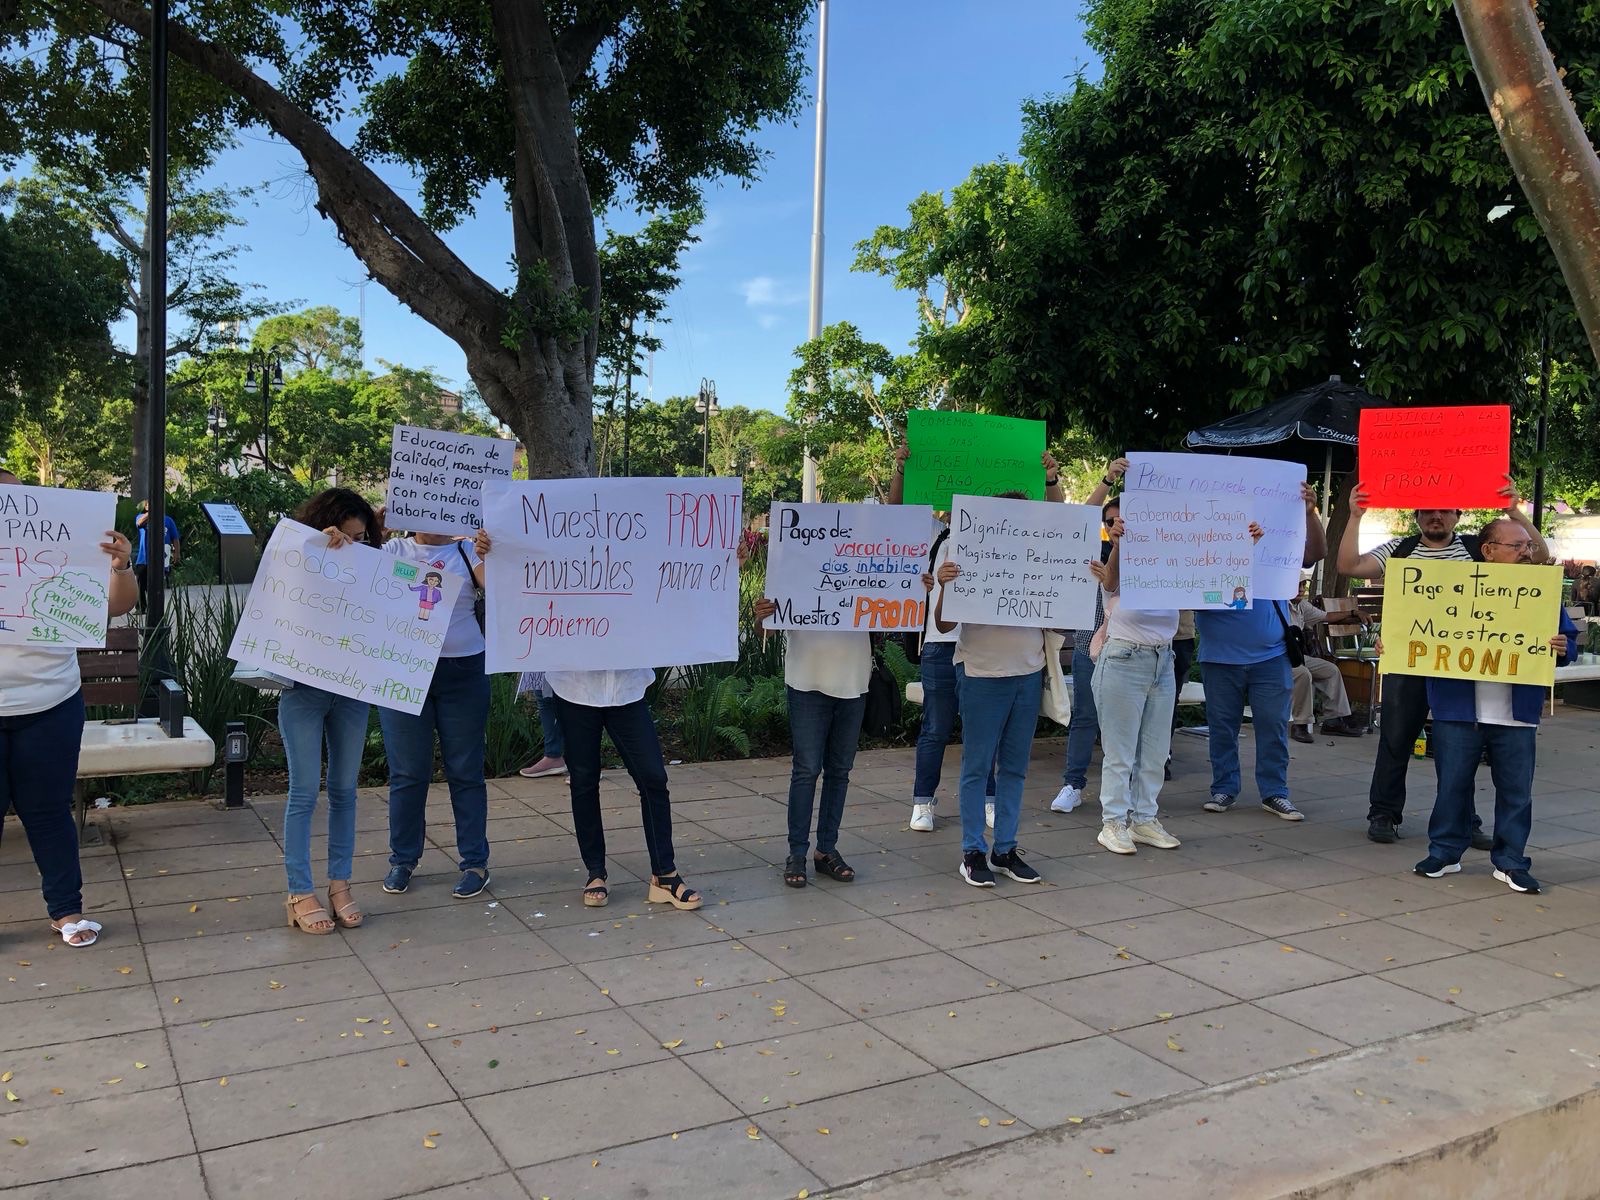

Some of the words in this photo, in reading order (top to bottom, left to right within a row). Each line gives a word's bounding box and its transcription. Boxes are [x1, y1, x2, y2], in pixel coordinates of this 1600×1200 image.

[984, 420, 1015, 431] TODOS
[1374, 411, 1444, 423] JUSTICIA
[1456, 410, 1465, 419] A
[1478, 410, 1502, 420] LAS
[400, 430, 475, 456] Educación
[484, 444, 500, 460] de
[1371, 448, 1396, 459] PARA
[1410, 447, 1431, 457] LOS
[391, 466, 405, 480] de
[452, 461, 510, 476] maestros
[975, 456, 1026, 470] NUESTRO
[936, 474, 973, 488] PAGO
[1137, 462, 1183, 491] PRONI
[1189, 480, 1209, 493] no
[1383, 473, 1454, 491] PRONI
[393, 486, 417, 499] con
[392, 500, 456, 523] laborales
[522, 492, 647, 541] Maestros
[665, 492, 740, 550] PRONI
[1124, 497, 1201, 524] Gobernador
[5, 518, 71, 542] PARA
[779, 508, 826, 546] Pagos
[829, 509, 853, 539] de:
[959, 508, 1063, 544] Dignificación
[1072, 522, 1088, 543] al
[1235, 531, 1245, 541] a
[834, 538, 929, 558] vacaciones
[956, 544, 1018, 564] Magisterio
[1026, 548, 1077, 565] Pedimos
[272, 525, 357, 585] Todos
[369, 557, 404, 600] los
[395, 566, 416, 578] HELLO
[821, 556, 850, 574] días
[1124, 551, 1160, 567] tener
[1166, 556, 1178, 567] un
[1184, 550, 1223, 567] sueldo
[1225, 552, 1250, 572] digno
[523, 545, 634, 591] invisibles
[656, 558, 704, 604] para
[710, 553, 730, 592] el
[818, 574, 888, 592] Aguinaldo
[900, 578, 912, 590] a
[984, 568, 1015, 582] justo
[1022, 573, 1043, 585] por
[1050, 573, 1063, 583] un
[1402, 566, 1444, 600] Pago
[1453, 583, 1465, 595] a
[953, 581, 977, 598] bajo
[983, 587, 993, 599] ya
[1001, 586, 1060, 598] realizado
[262, 574, 377, 624] maestros
[385, 614, 445, 649] valemos
[773, 596, 841, 627] Maestros
[839, 596, 854, 609] del
[996, 596, 1054, 619] PRONI
[1445, 605, 1458, 618] a
[1470, 601, 1497, 622] los
[247, 599, 263, 620] lo
[274, 615, 335, 647] mismo
[515, 600, 610, 660] gobierno
[1409, 618, 1525, 647] Maestros
[1527, 637, 1554, 658] del
[1407, 639, 1520, 676] PRONI
